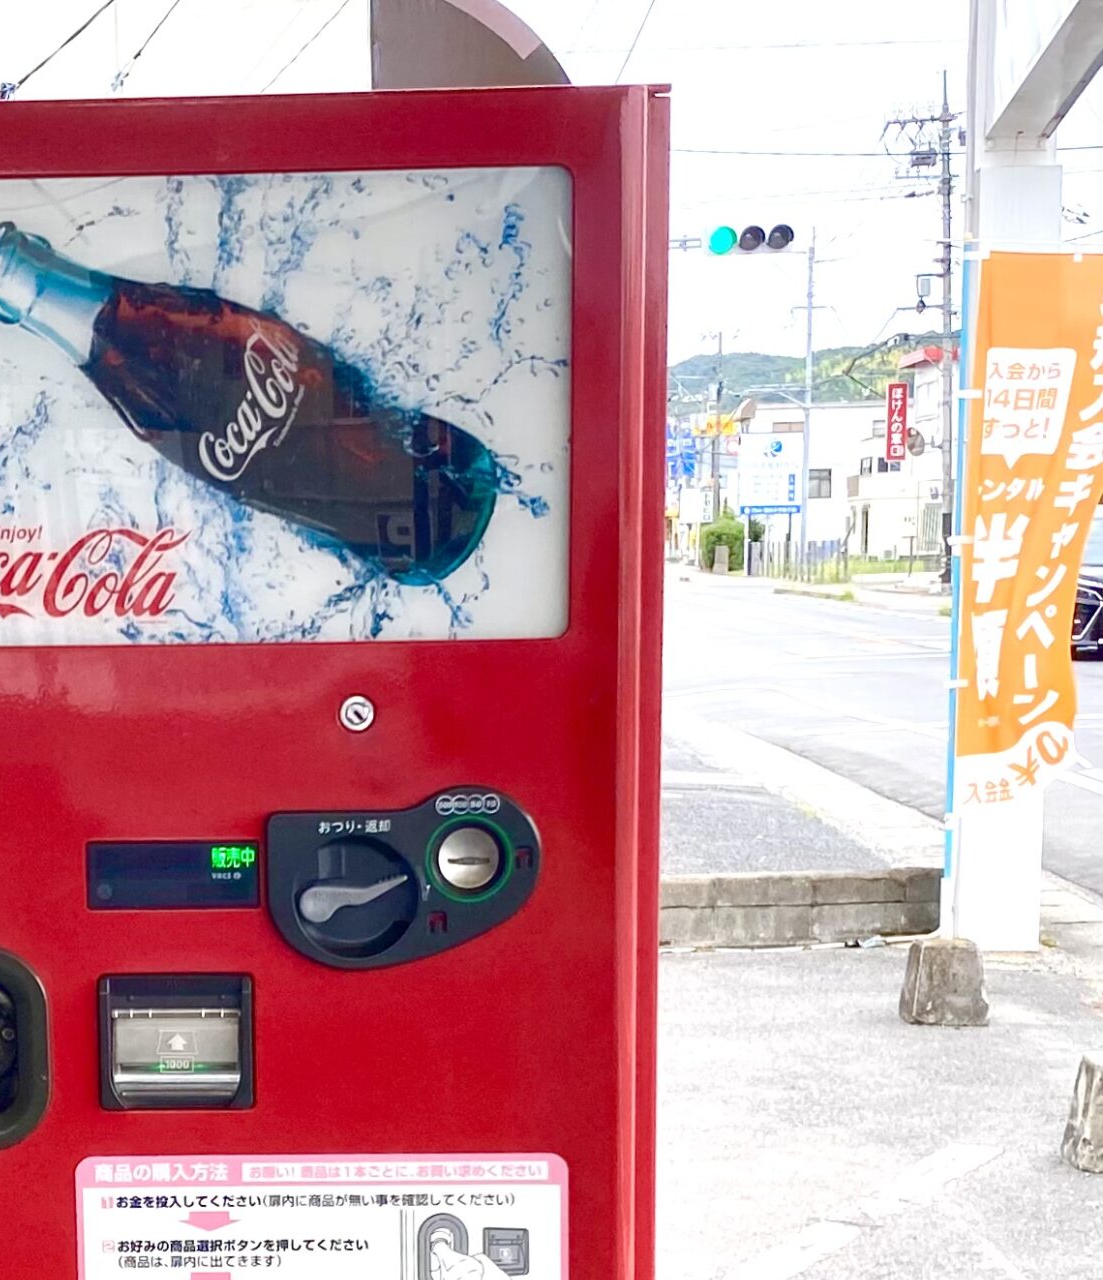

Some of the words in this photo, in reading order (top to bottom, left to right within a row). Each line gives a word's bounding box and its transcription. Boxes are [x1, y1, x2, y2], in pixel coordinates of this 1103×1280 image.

[989, 362, 1061, 381] 入会から
[987, 387, 1058, 411] 14日間
[890, 387, 904, 457] ほけんの窓口
[978, 477, 1045, 501] ンタル
[318, 819, 391, 834] おつり・返却
[211, 847, 255, 868] 販売中
[165, 1060, 190, 1069] 1000
[94, 1163, 228, 1183] 商品の購入方法
[117, 1239, 369, 1252] お好みの商品選択ボタンを押してください
